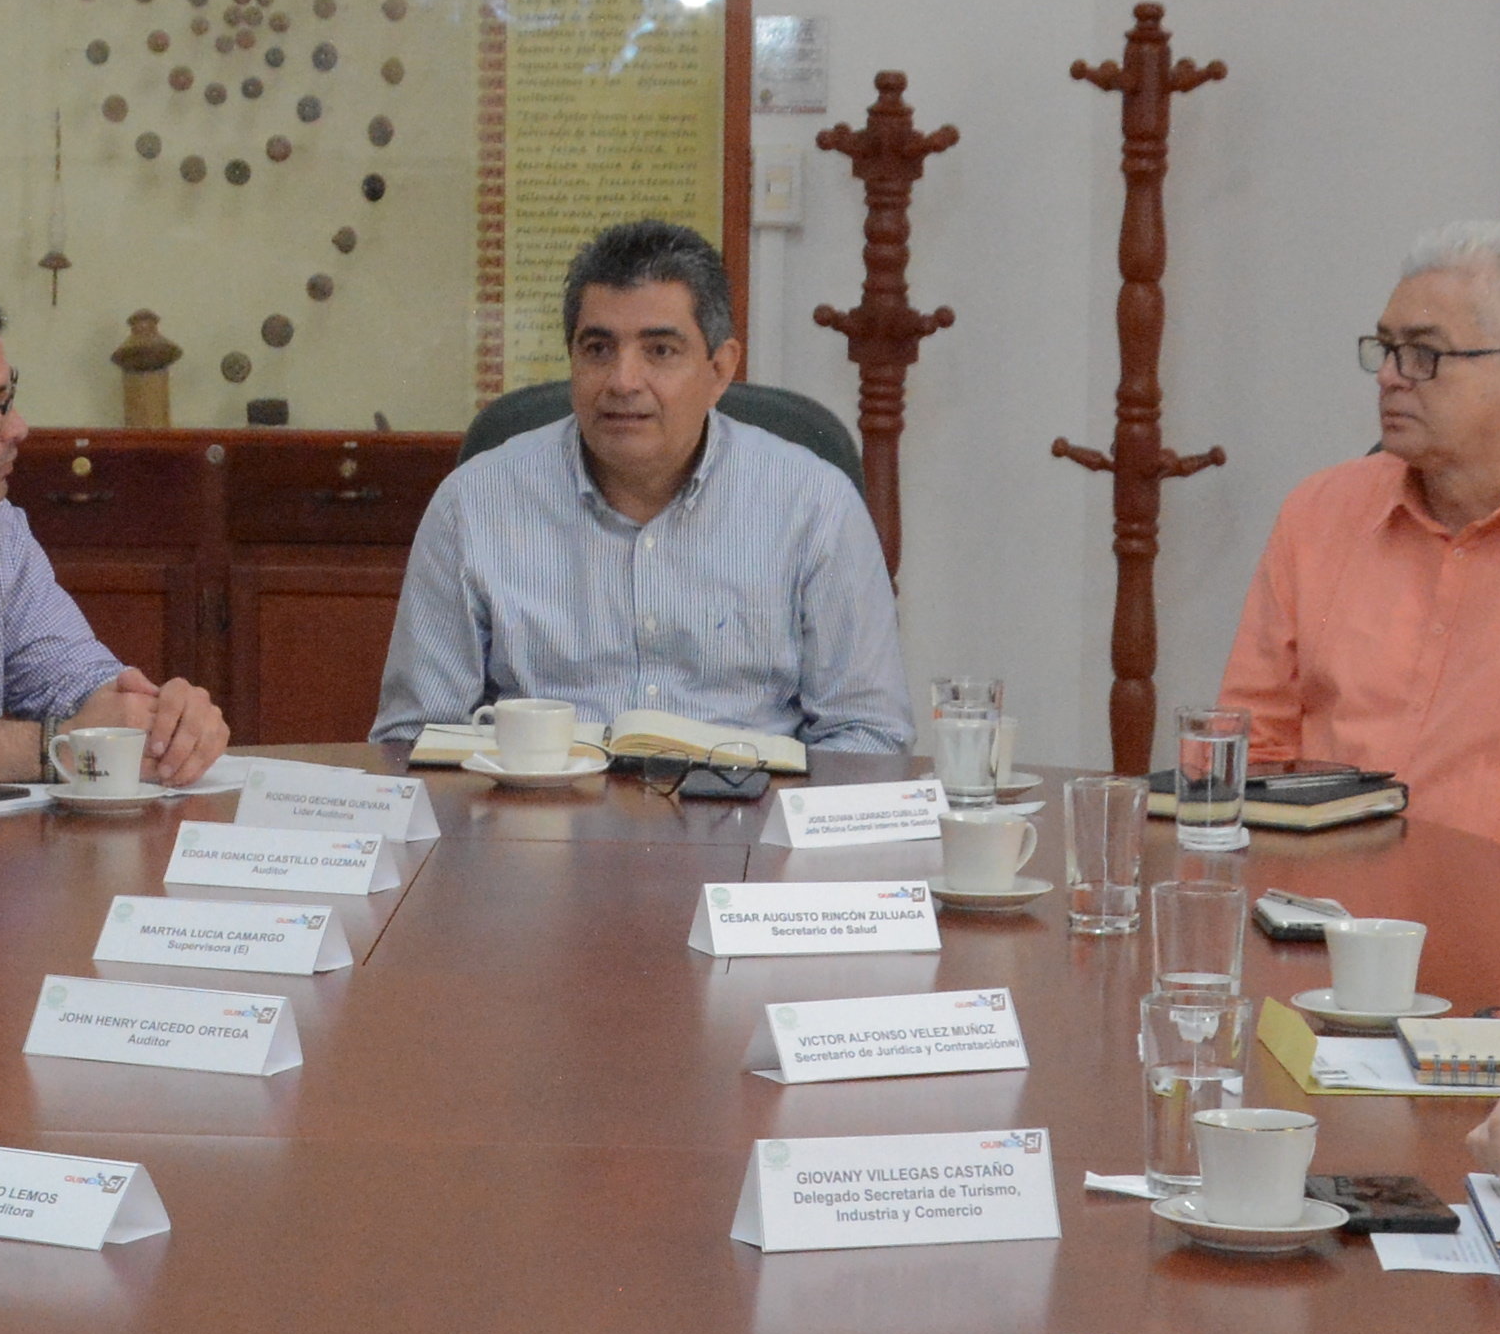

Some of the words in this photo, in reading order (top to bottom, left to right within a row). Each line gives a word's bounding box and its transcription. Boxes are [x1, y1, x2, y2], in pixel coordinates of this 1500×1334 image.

[347, 798, 392, 812] GUEVARA
[181, 848, 219, 861] EDGAR
[220, 851, 266, 864] IGNACIO
[266, 853, 320, 866] CASTILLO
[320, 855, 368, 869] GUZMAN
[251, 864, 289, 877] Auditor
[719, 912, 761, 924] CESAR
[762, 911, 820, 923] AUGUSTO
[867, 909, 926, 922] ZULUAGA
[140, 924, 189, 938] MARTHA
[189, 927, 225, 941] LUCIA
[226, 930, 286, 944] CAMARGO
[770, 925, 828, 937] Secretario
[829, 925, 845, 936] de
[845, 923, 878, 936] Salud
[166, 938, 233, 956] Supervisora
[233, 943, 250, 957] (E)
[58, 1011, 94, 1025] JOHN
[95, 1014, 140, 1031] HENRY
[138, 1019, 195, 1035] CAICEDO
[197, 1024, 250, 1041] ORTEGA
[798, 1033, 847, 1048] VICTOR
[848, 1029, 908, 1044] ALFONSO
[909, 1026, 950, 1040] VELEZ
[951, 1022, 997, 1037] MUÑOZ
[127, 1033, 172, 1048] Auditor
[794, 1047, 856, 1064] Secretario
[858, 1046, 874, 1059] de
[924, 1046, 933, 1057] y
[796, 1169, 862, 1186] GIOVANY
[866, 1166, 940, 1183] VILLEGAS
[943, 1161, 1015, 1180] CASTAÑO
[8, 1187, 59, 1205] LEMOS
[793, 1189, 861, 1208] Delegado
[938, 1184, 957, 1199] de
[959, 1183, 1022, 1200] Turismo,
[836, 1207, 900, 1223] Industria
[902, 1210, 912, 1223] y
[914, 1203, 984, 1220] Comercio
